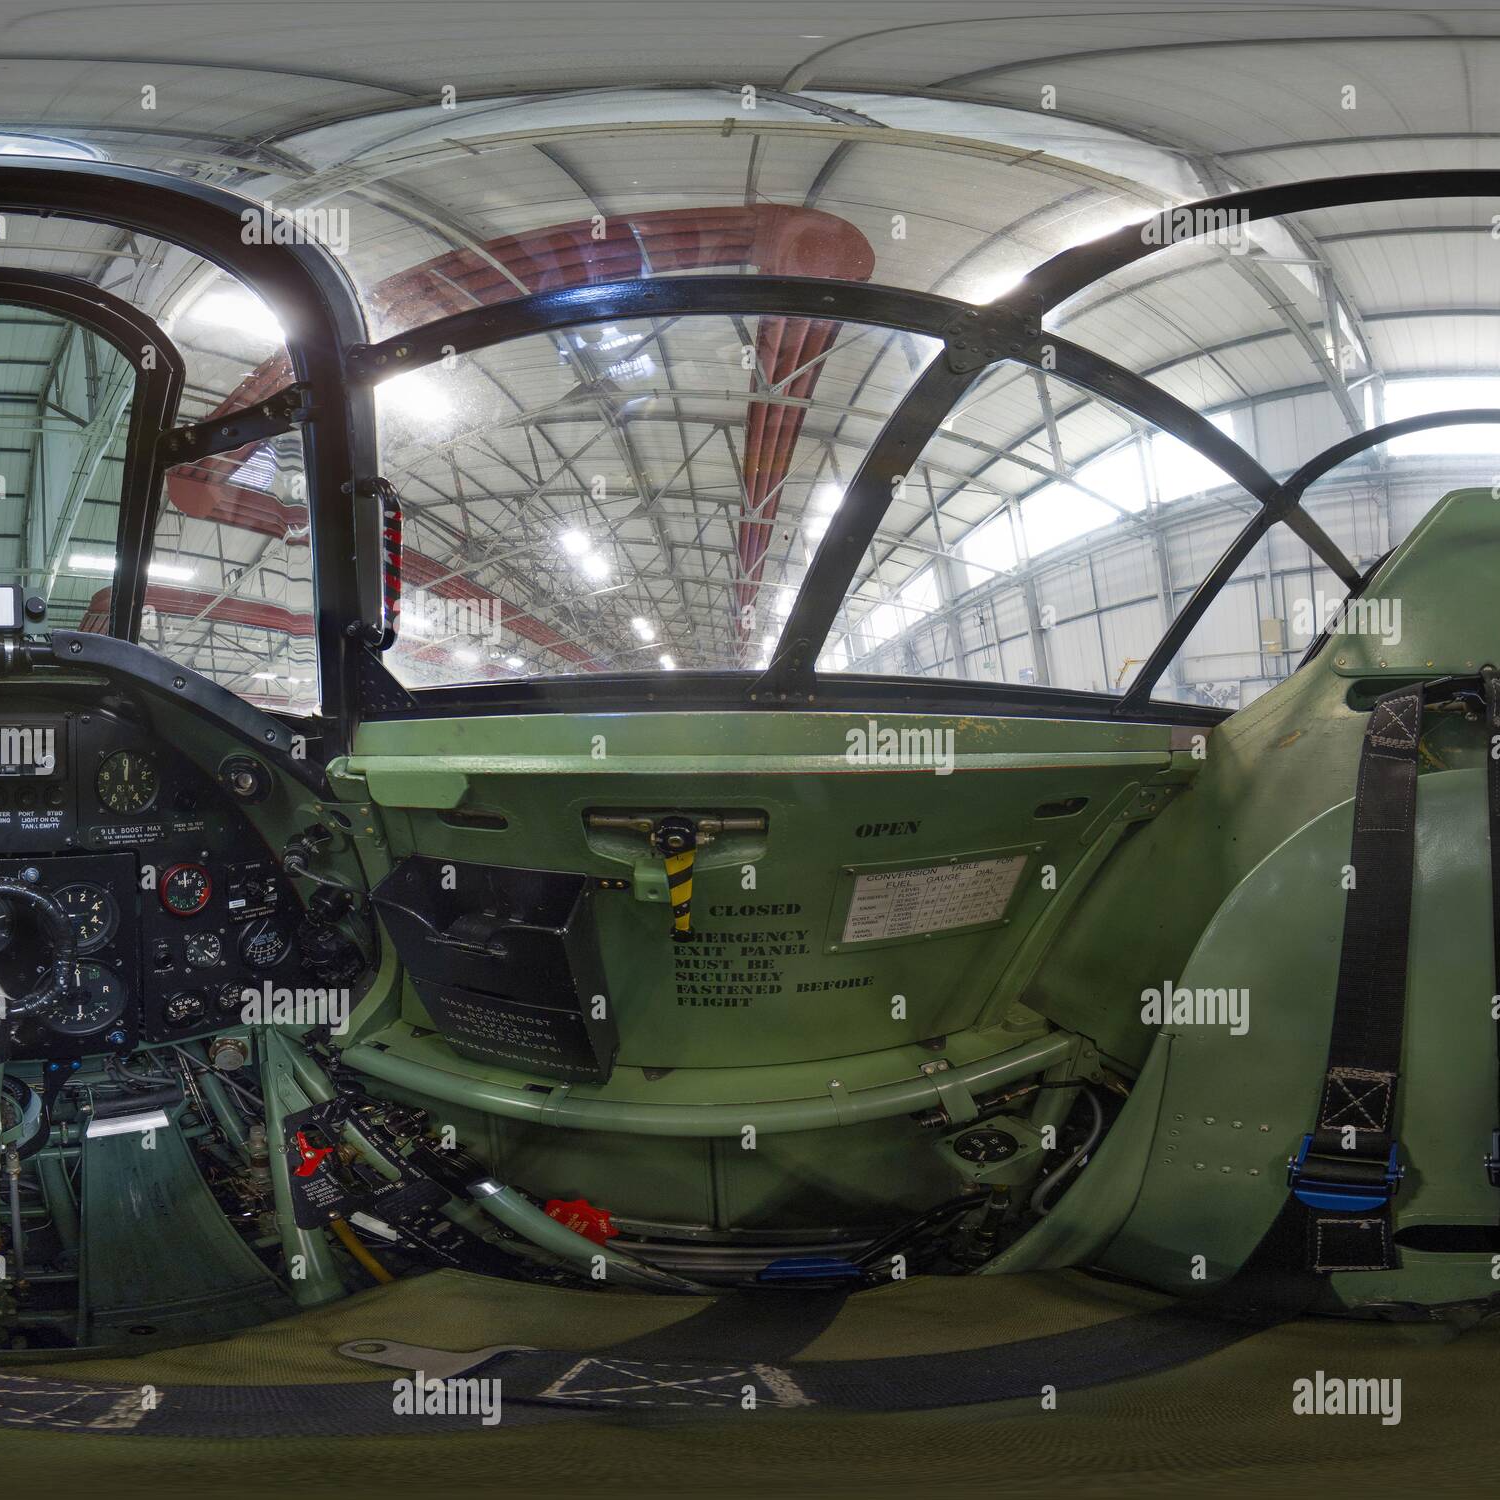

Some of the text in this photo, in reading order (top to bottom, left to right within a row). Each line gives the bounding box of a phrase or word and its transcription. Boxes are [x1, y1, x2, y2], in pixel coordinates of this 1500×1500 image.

[103, 771, 110, 781] 8
[141, 771, 148, 780] 2
[111, 794, 118, 802] 6
[39, 822, 60, 830] EMPTY
[120, 826, 143, 834] BOOST
[147, 824, 162, 832] MAX
[855, 820, 921, 838] OPEN
[866, 868, 938, 882] CONVERSION
[952, 862, 980, 872] TABLE
[886, 868, 995, 889] FUEL GAUGE DIAL
[80, 893, 86, 902] 2
[91, 902, 100, 911] 4
[709, 903, 802, 917] CLOSED
[90, 915, 99, 924] 4
[80, 926, 87, 934] 2
[692, 930, 810, 943] MERGENCY
[674, 944, 810, 957] EXIT PANEL
[675, 959, 774, 970] MUST BE
[675, 972, 784, 982] SECURELY
[676, 976, 875, 995] FASTENED BEFORE
[677, 997, 753, 1008] FLIGHT
[306, 1185, 333, 1198] RETURNED
[373, 1183, 395, 1197] DOWN
